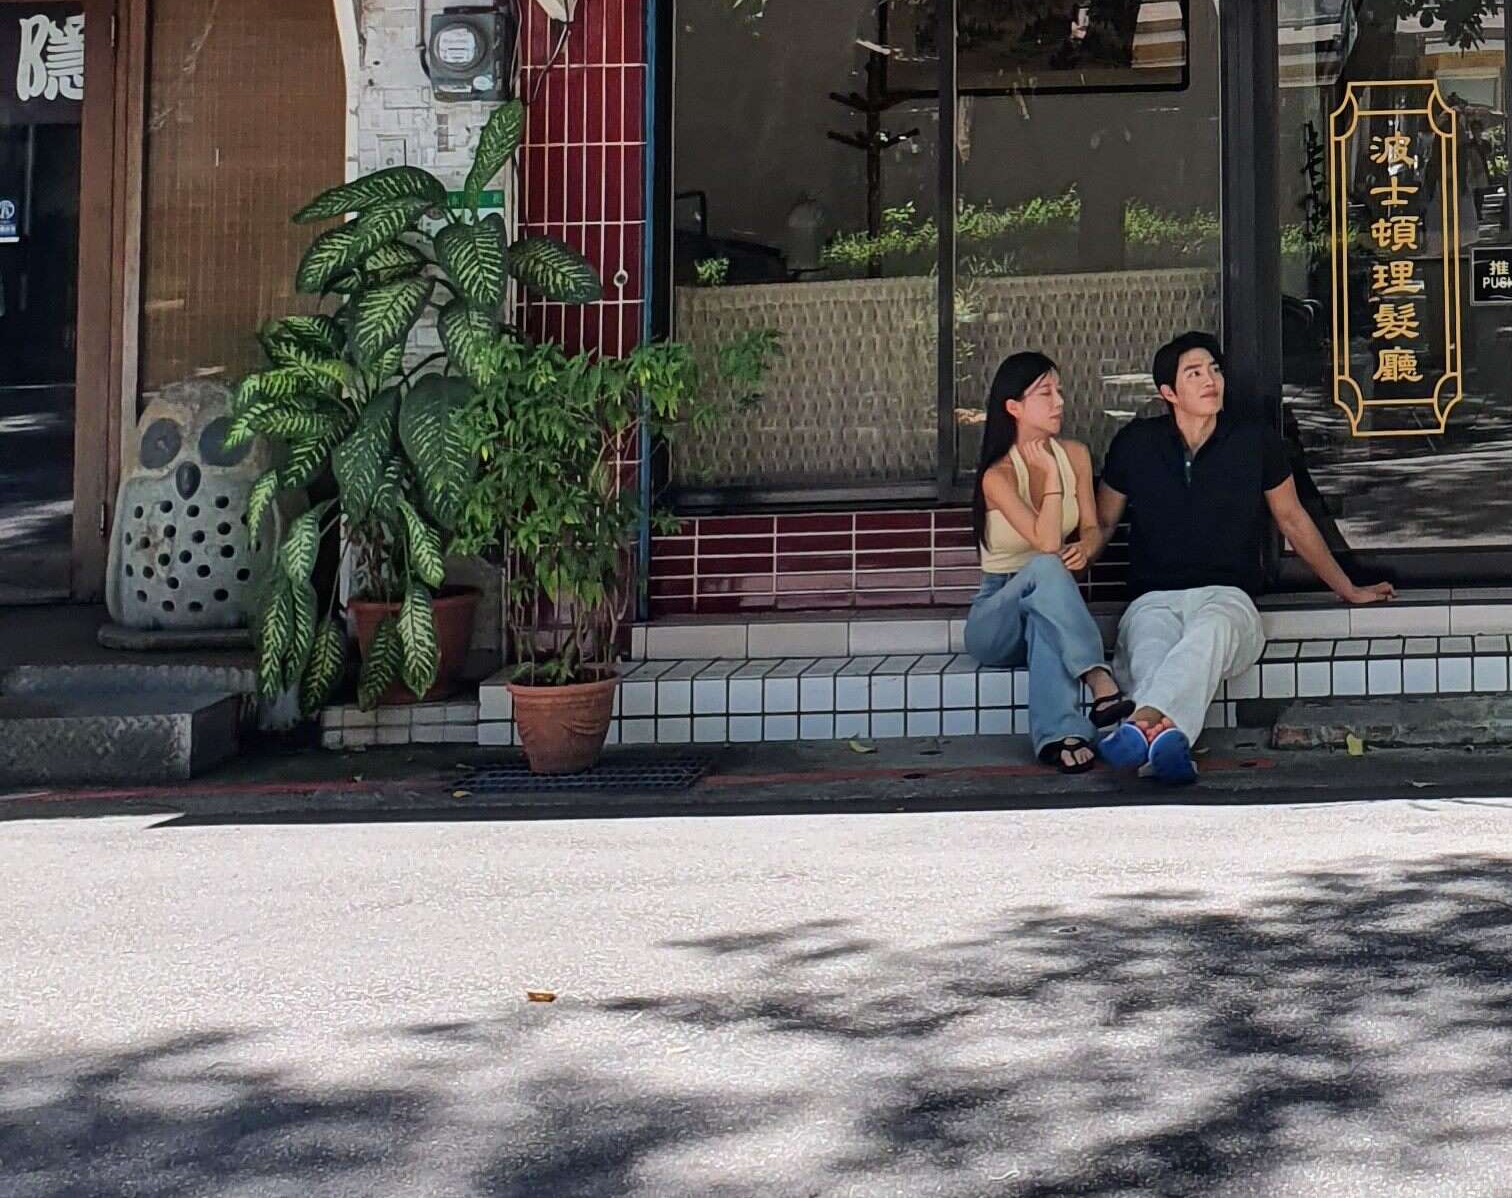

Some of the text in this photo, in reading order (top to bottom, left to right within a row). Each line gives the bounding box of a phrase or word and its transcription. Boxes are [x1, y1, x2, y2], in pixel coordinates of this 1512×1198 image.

[1369, 131, 1423, 382] 波士頓理髮廳
[1489, 260, 1509, 275] 推
